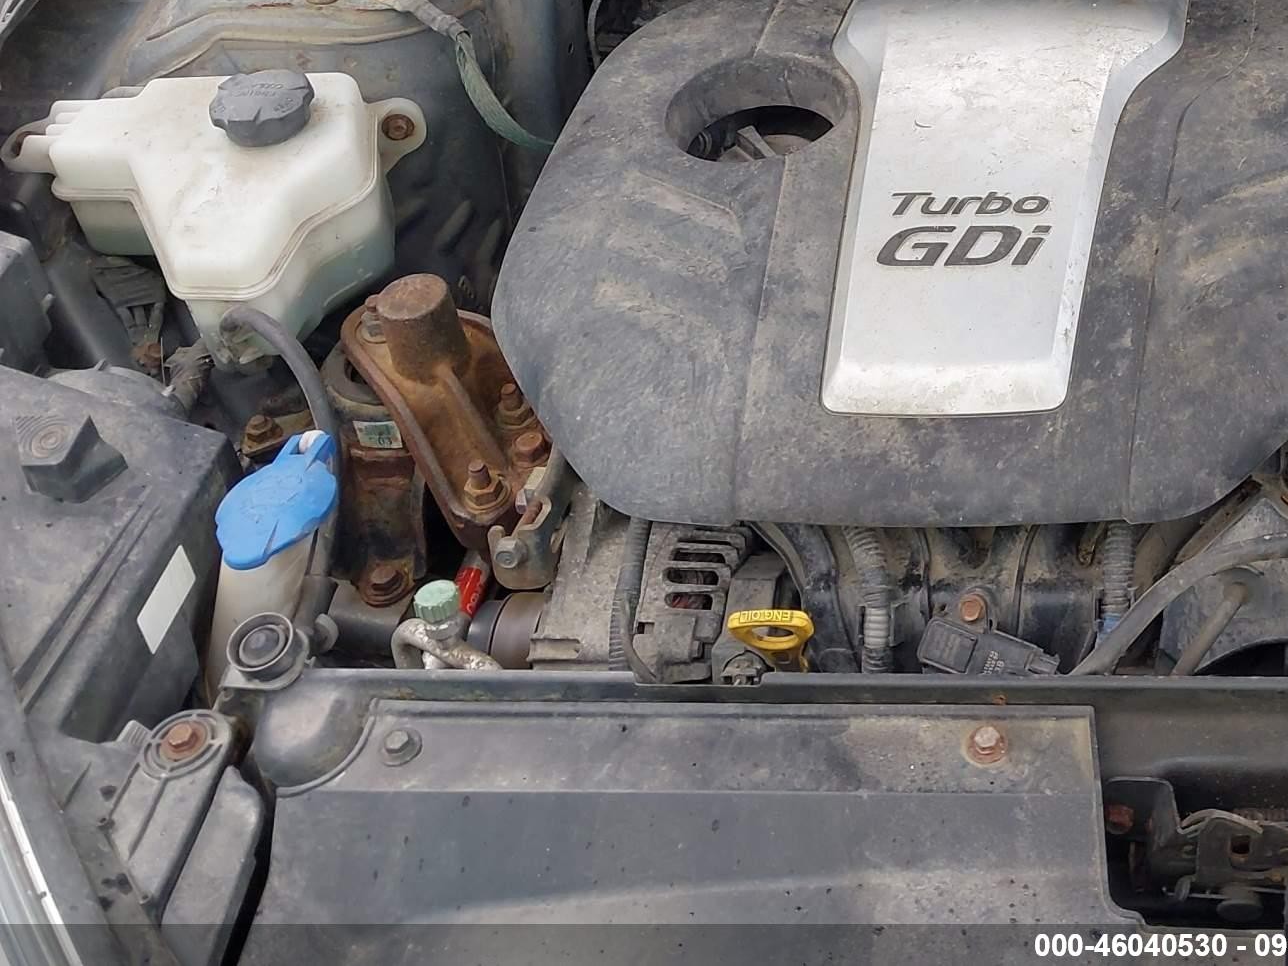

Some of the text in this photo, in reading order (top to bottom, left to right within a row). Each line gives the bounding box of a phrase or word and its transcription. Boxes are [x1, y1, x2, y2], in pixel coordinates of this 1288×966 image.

[891, 191, 1050, 216] Turbo
[876, 225, 1053, 267] GDi
[763, 610, 792, 622] ENG
